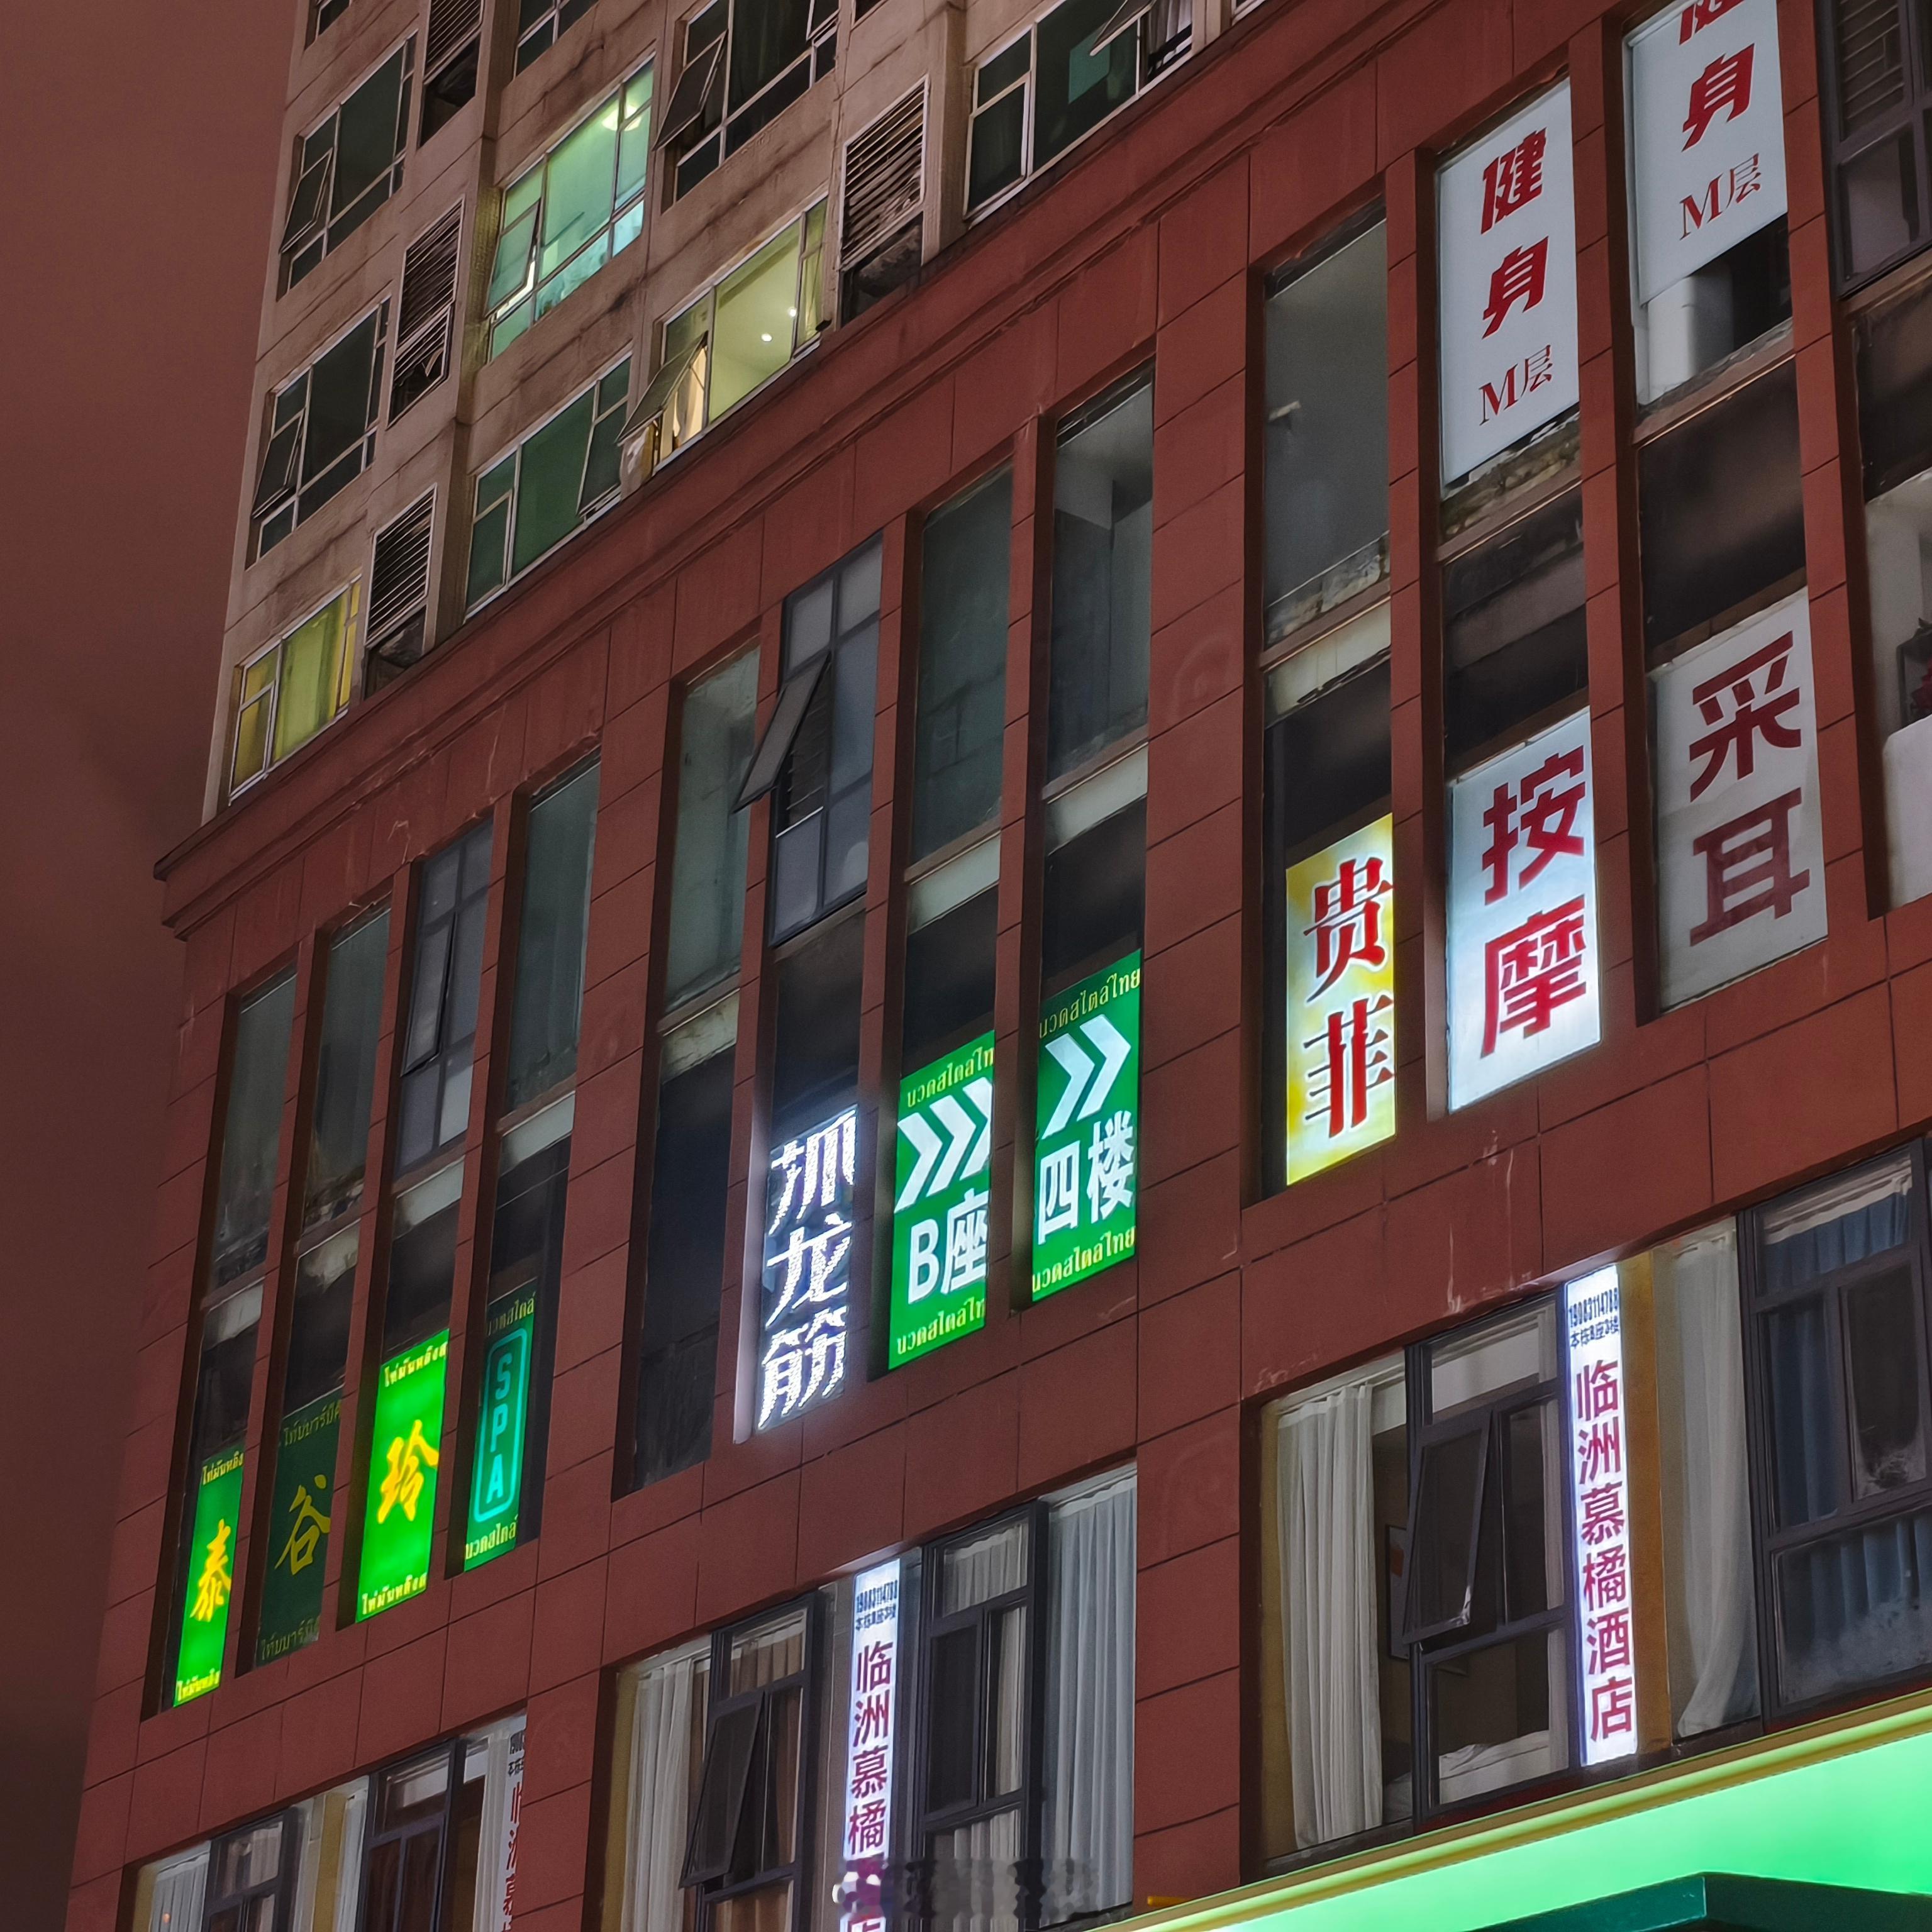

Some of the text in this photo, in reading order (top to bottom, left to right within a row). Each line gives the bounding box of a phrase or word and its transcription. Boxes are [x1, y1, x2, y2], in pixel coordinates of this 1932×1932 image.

[1479, 127, 1548, 340] 健身
[1680, 153, 1762, 240] M层
[1479, 345, 1553, 426] M层
[1689, 631, 1810, 947] 采耳
[1480, 746, 1587, 1058] 按摩
[1303, 858, 1394, 1138] 贵菲
[908, 1187, 990, 1305] B座
[1038, 1111, 1135, 1245] 四楼
[758, 1109, 856, 1430] 抓龙筋
[487, 1353, 513, 1501] SPA
[189, 1519, 231, 1623] 泰
[274, 1474, 331, 1575] 谷
[1576, 1358, 1633, 1741] 临洲慕橘酒店
